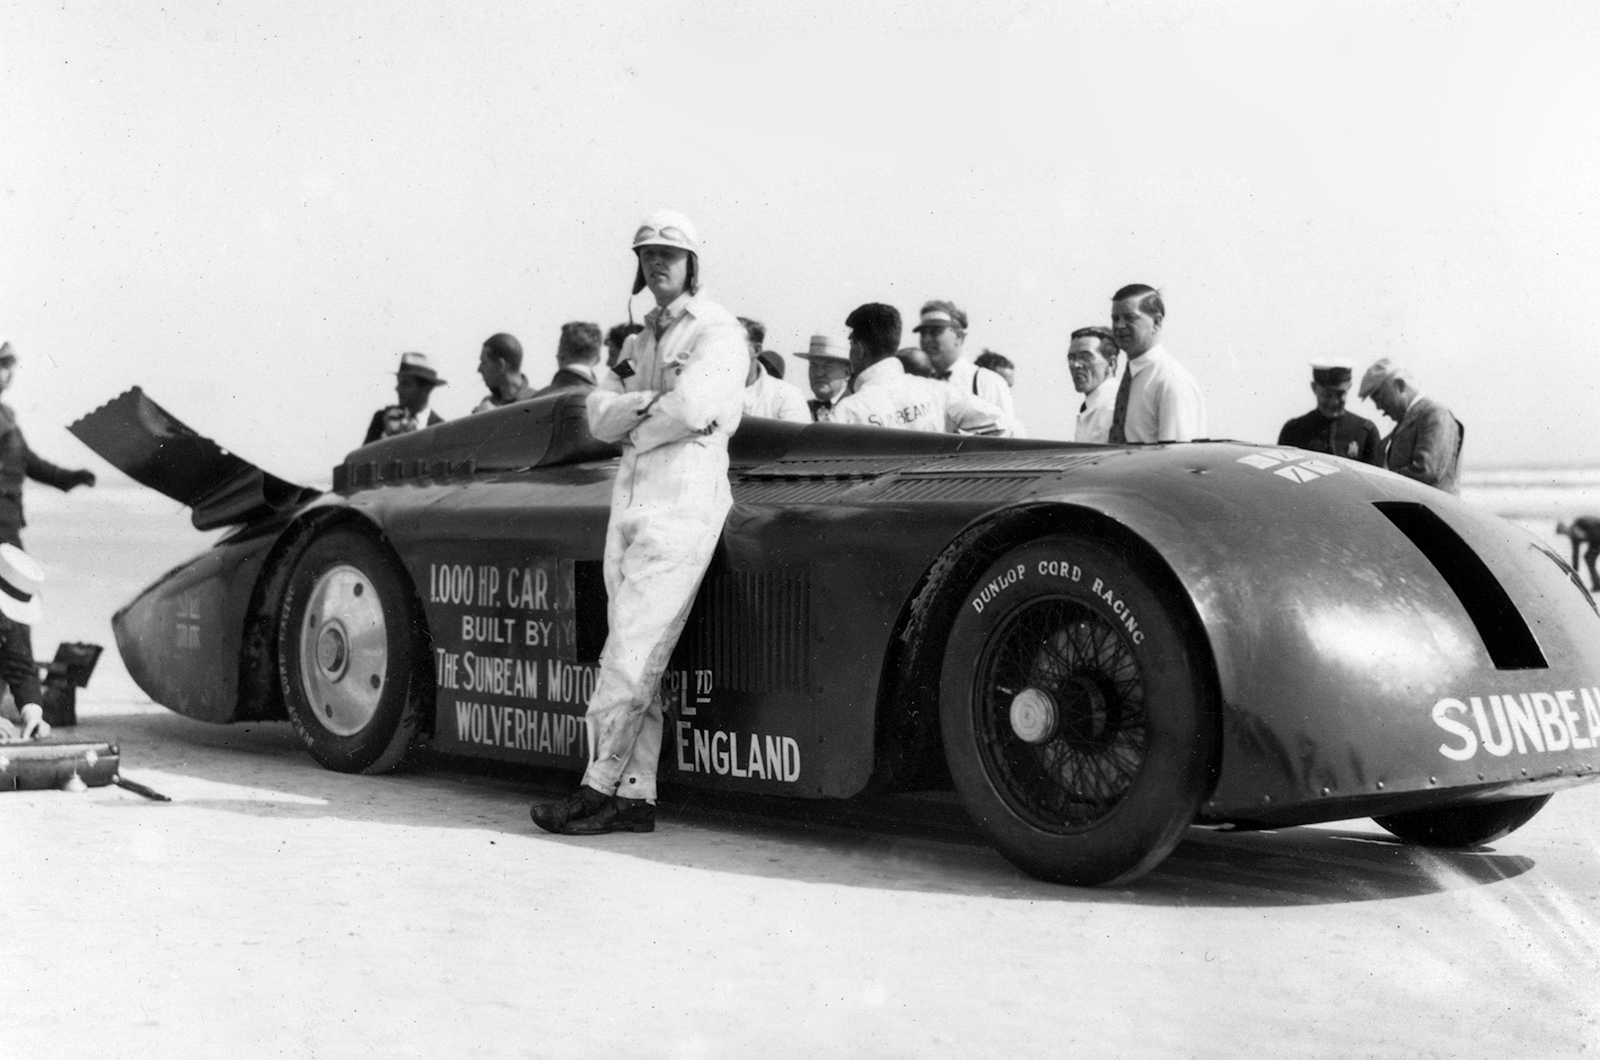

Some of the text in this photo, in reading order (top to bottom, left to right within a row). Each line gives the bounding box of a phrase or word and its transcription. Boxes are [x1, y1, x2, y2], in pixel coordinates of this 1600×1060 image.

[868, 403, 931, 426] SBEAM
[972, 564, 1026, 614] DUNLOP
[1038, 560, 1082, 582] CORD
[462, 615, 553, 647] BUILT BY
[436, 648, 460, 690] THE
[463, 651, 538, 700] SUNBEAM
[547, 659, 602, 706] MOTO
[455, 700, 801, 783] WOLVERHAMPT ENGLAND
[1431, 686, 1600, 762] SUNBEA
